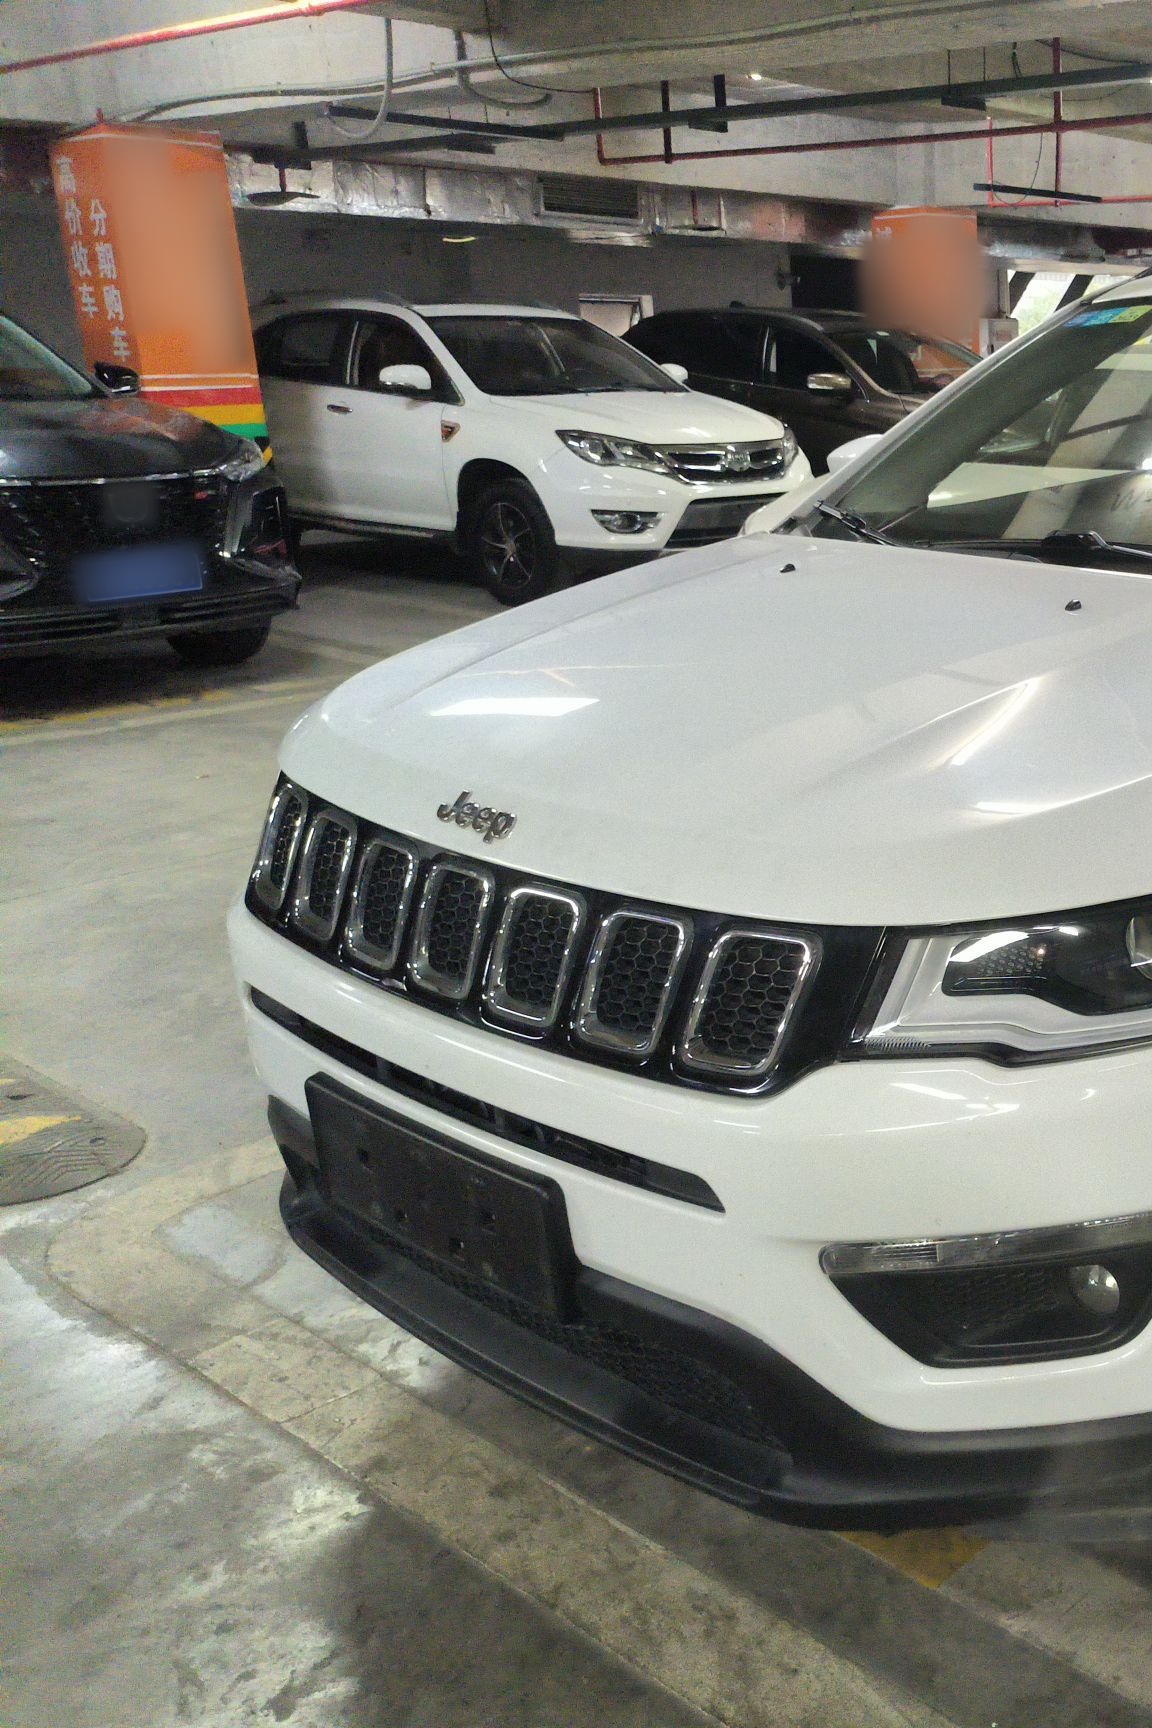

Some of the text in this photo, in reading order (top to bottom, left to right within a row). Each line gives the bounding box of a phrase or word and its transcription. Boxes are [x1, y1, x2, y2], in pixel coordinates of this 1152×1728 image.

[56, 155, 99, 319] 高价收车
[89, 198, 132, 363] 分期购车
[437, 789, 517, 843] Jeep
